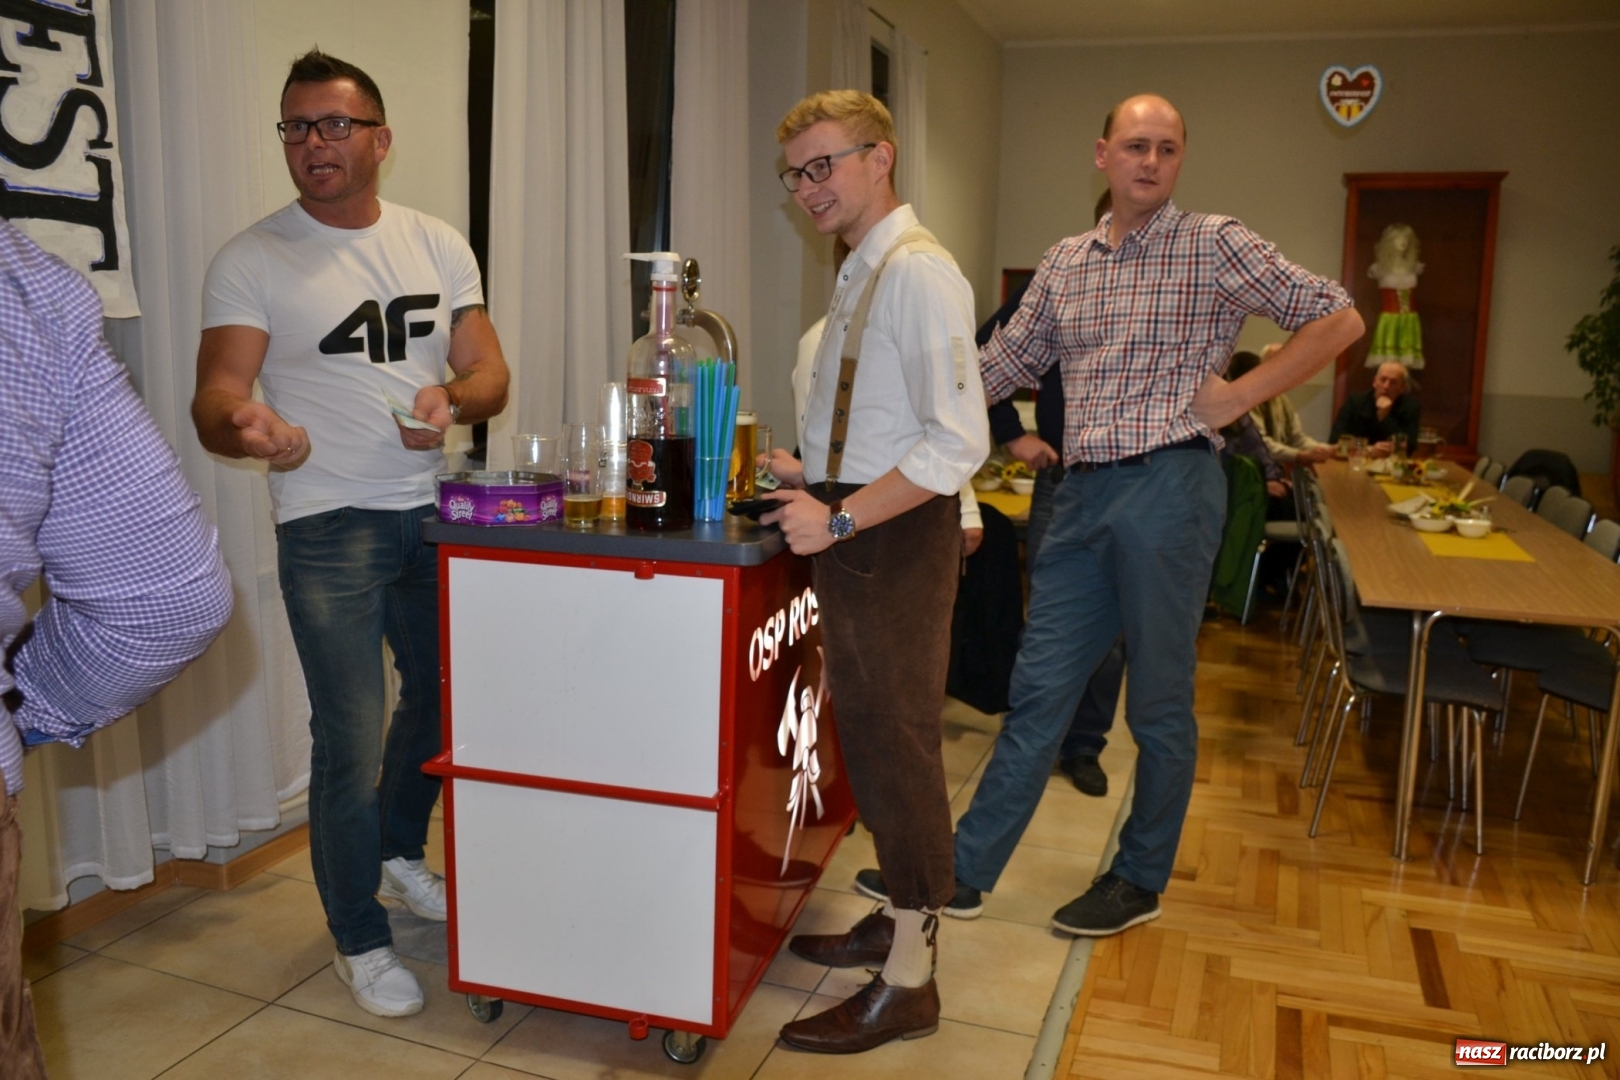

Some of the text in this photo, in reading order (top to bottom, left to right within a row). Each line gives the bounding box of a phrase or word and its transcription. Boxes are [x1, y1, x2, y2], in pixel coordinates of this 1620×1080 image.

[0, 0, 119, 271] EST
[318, 293, 440, 364] 4F
[449, 499, 476, 512] Quality
[451, 509, 473, 521] Street
[749, 607, 786, 682] OSP
